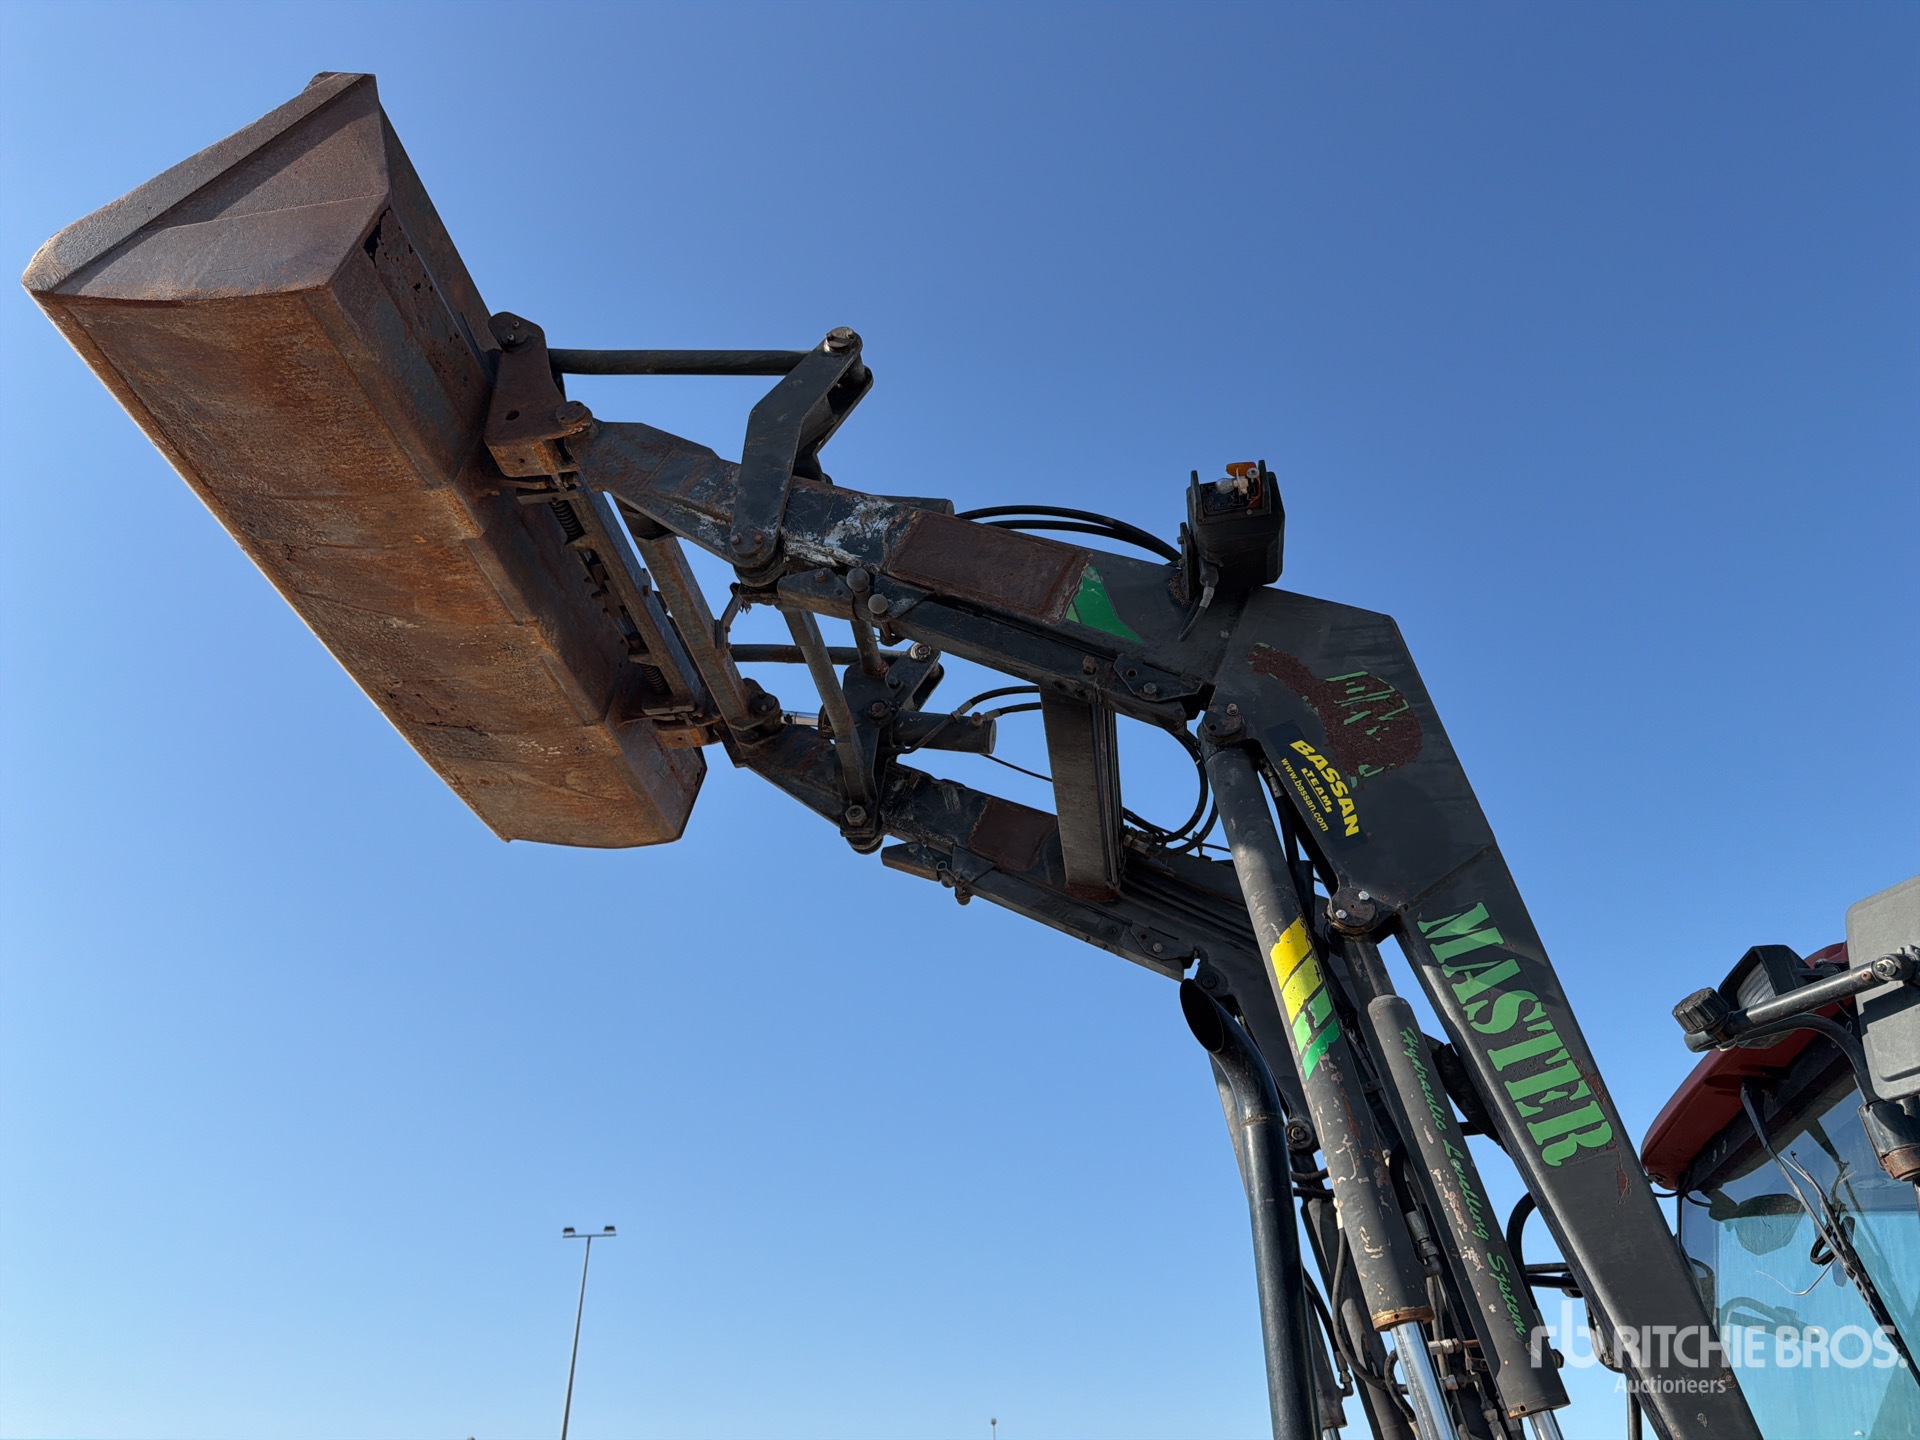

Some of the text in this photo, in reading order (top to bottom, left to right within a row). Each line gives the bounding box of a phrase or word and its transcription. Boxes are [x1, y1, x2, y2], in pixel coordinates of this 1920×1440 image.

[1281, 757, 1329, 832] www.bassan.com
[1290, 740, 1360, 837] BASSAN
[1306, 770, 1332, 808] TEAM
[1417, 901, 1613, 1167] MASTER
[1400, 1026, 1447, 1131] Hydraulic
[1442, 1138, 1490, 1241] Levelling
